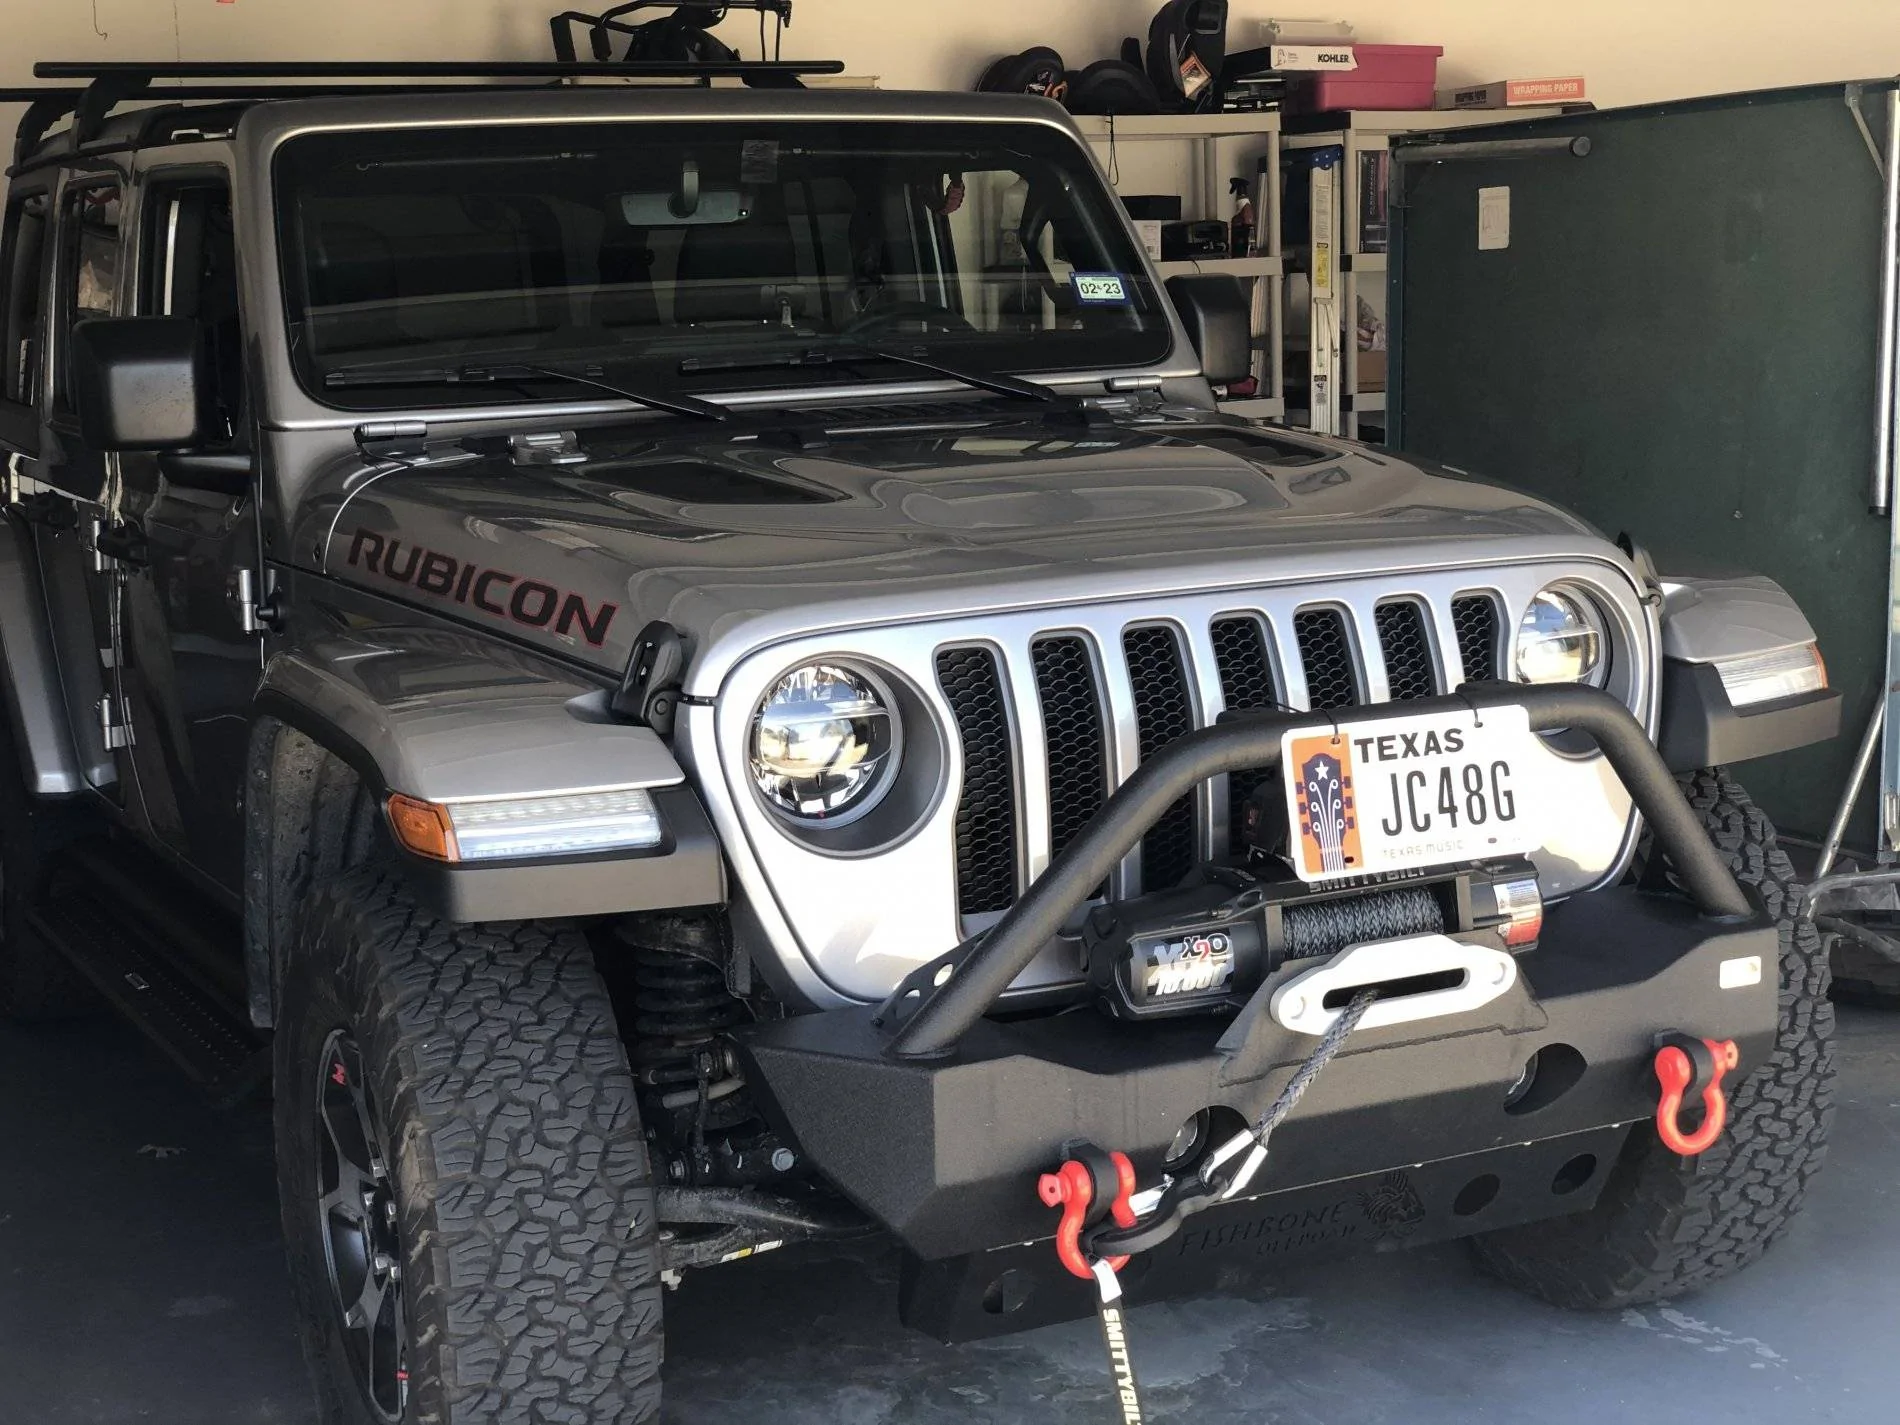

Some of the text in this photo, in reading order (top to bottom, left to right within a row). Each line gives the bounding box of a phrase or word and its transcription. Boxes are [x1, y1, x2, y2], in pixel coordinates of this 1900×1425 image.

[1317, 54, 1349, 63] KOHLER
[1513, 83, 1578, 95] WRAPPING PAPER
[347, 527, 619, 648] RUBICON
[1354, 728, 1465, 763] TEXAS
[1381, 760, 1516, 837] JC48G
[1383, 845, 1423, 859] TEXAS
[1179, 1200, 1349, 1256] FISHBONE
[1103, 1308, 1142, 1425] SMITTYBIL
